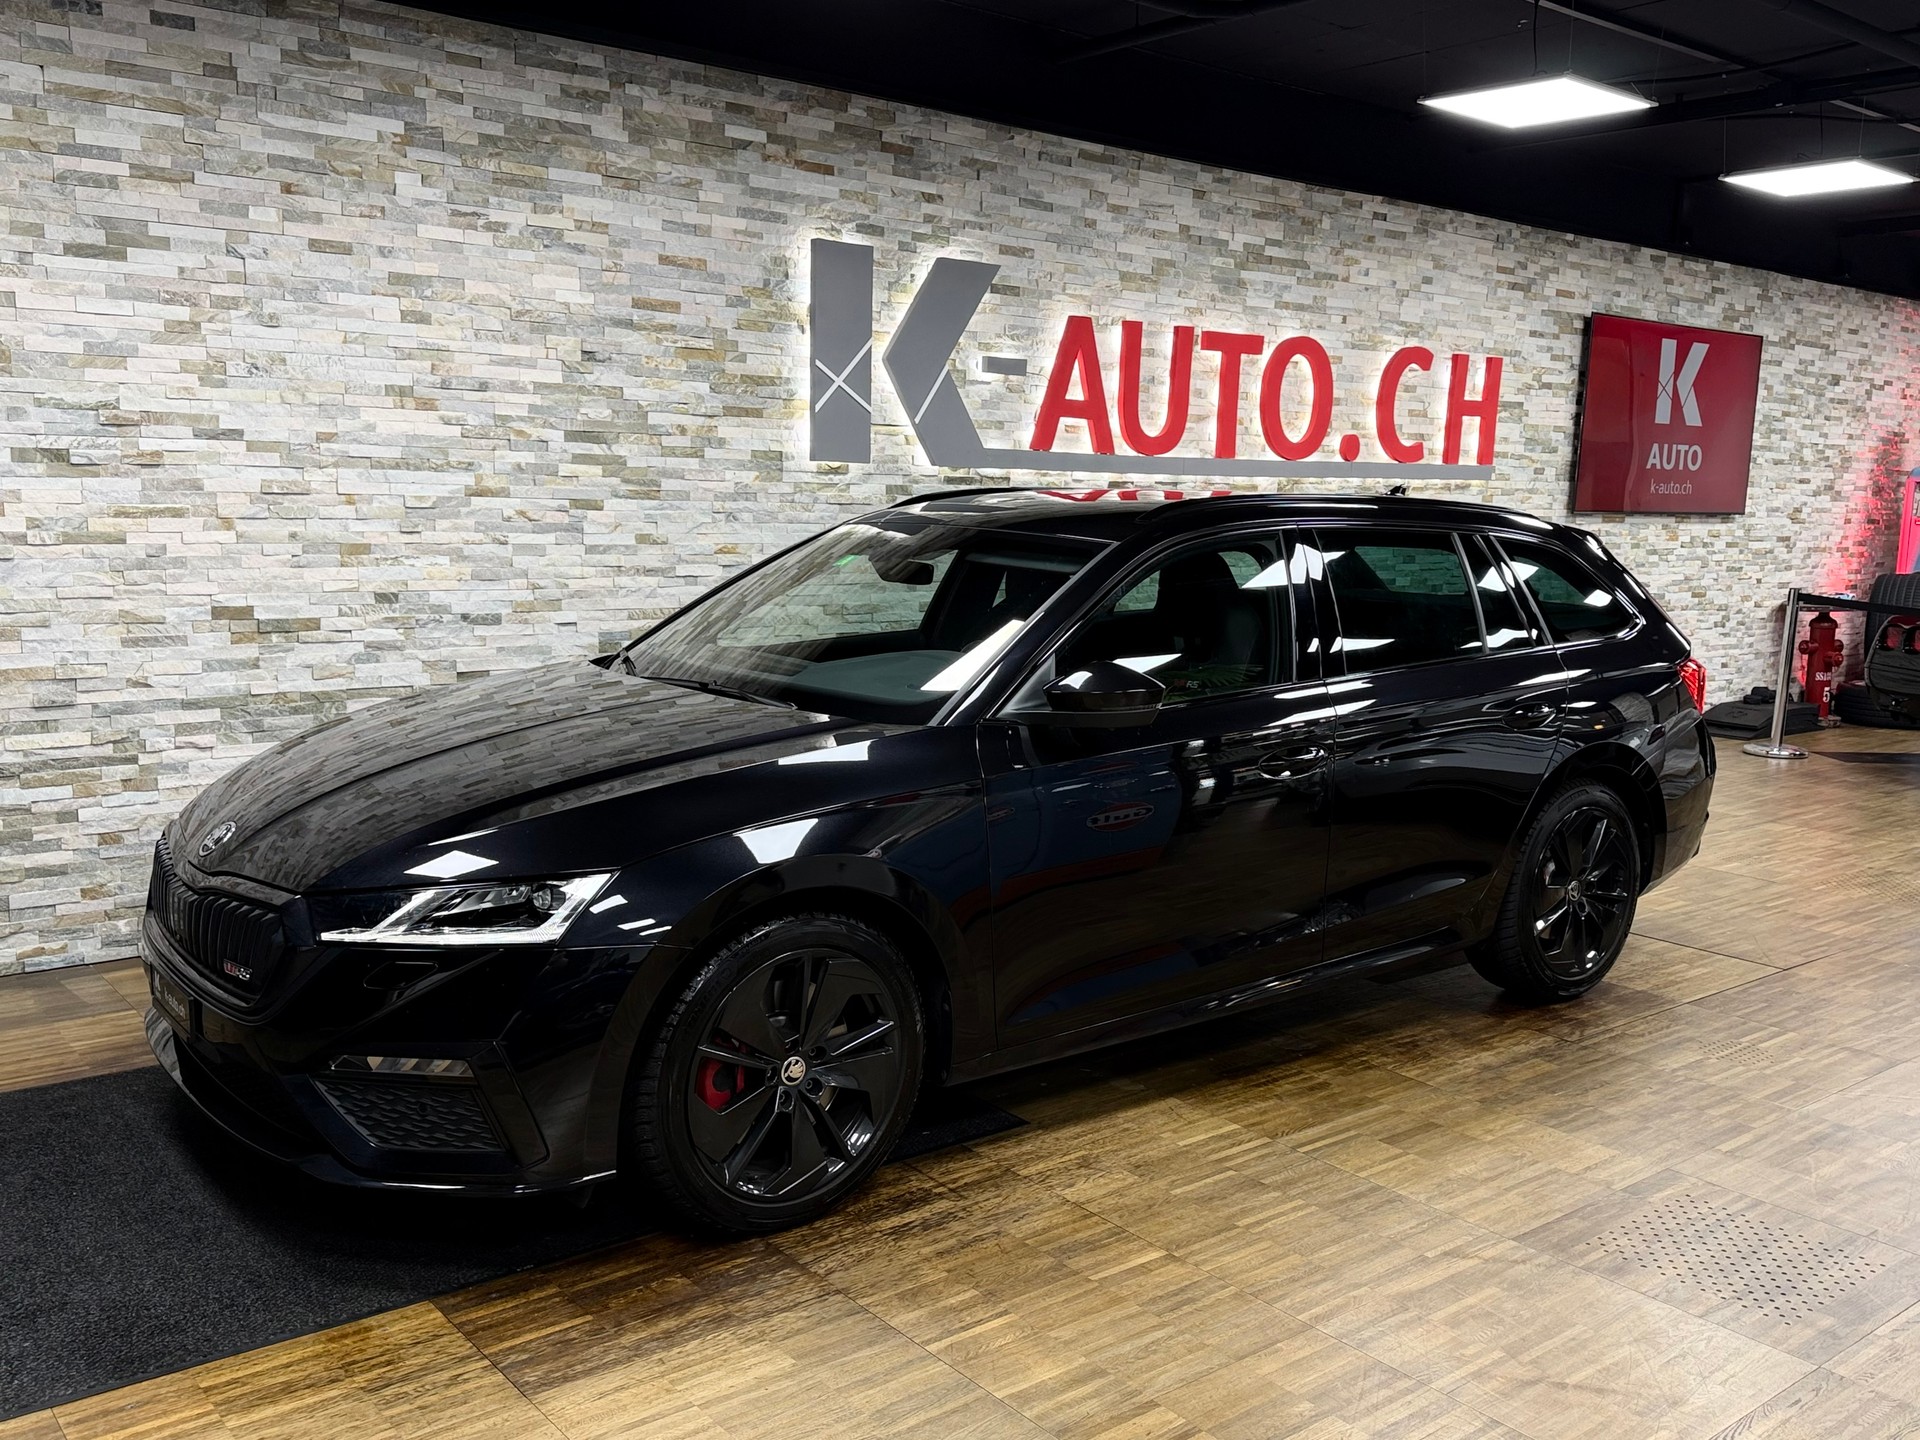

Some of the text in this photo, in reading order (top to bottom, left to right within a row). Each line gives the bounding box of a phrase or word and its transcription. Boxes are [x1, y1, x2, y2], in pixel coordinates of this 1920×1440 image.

[1655, 338, 1710, 427] K
[1646, 443, 1702, 471] AUTO
[1650, 478, 1692, 494] k-auto.ch
[1823, 686, 1831, 703] 5
